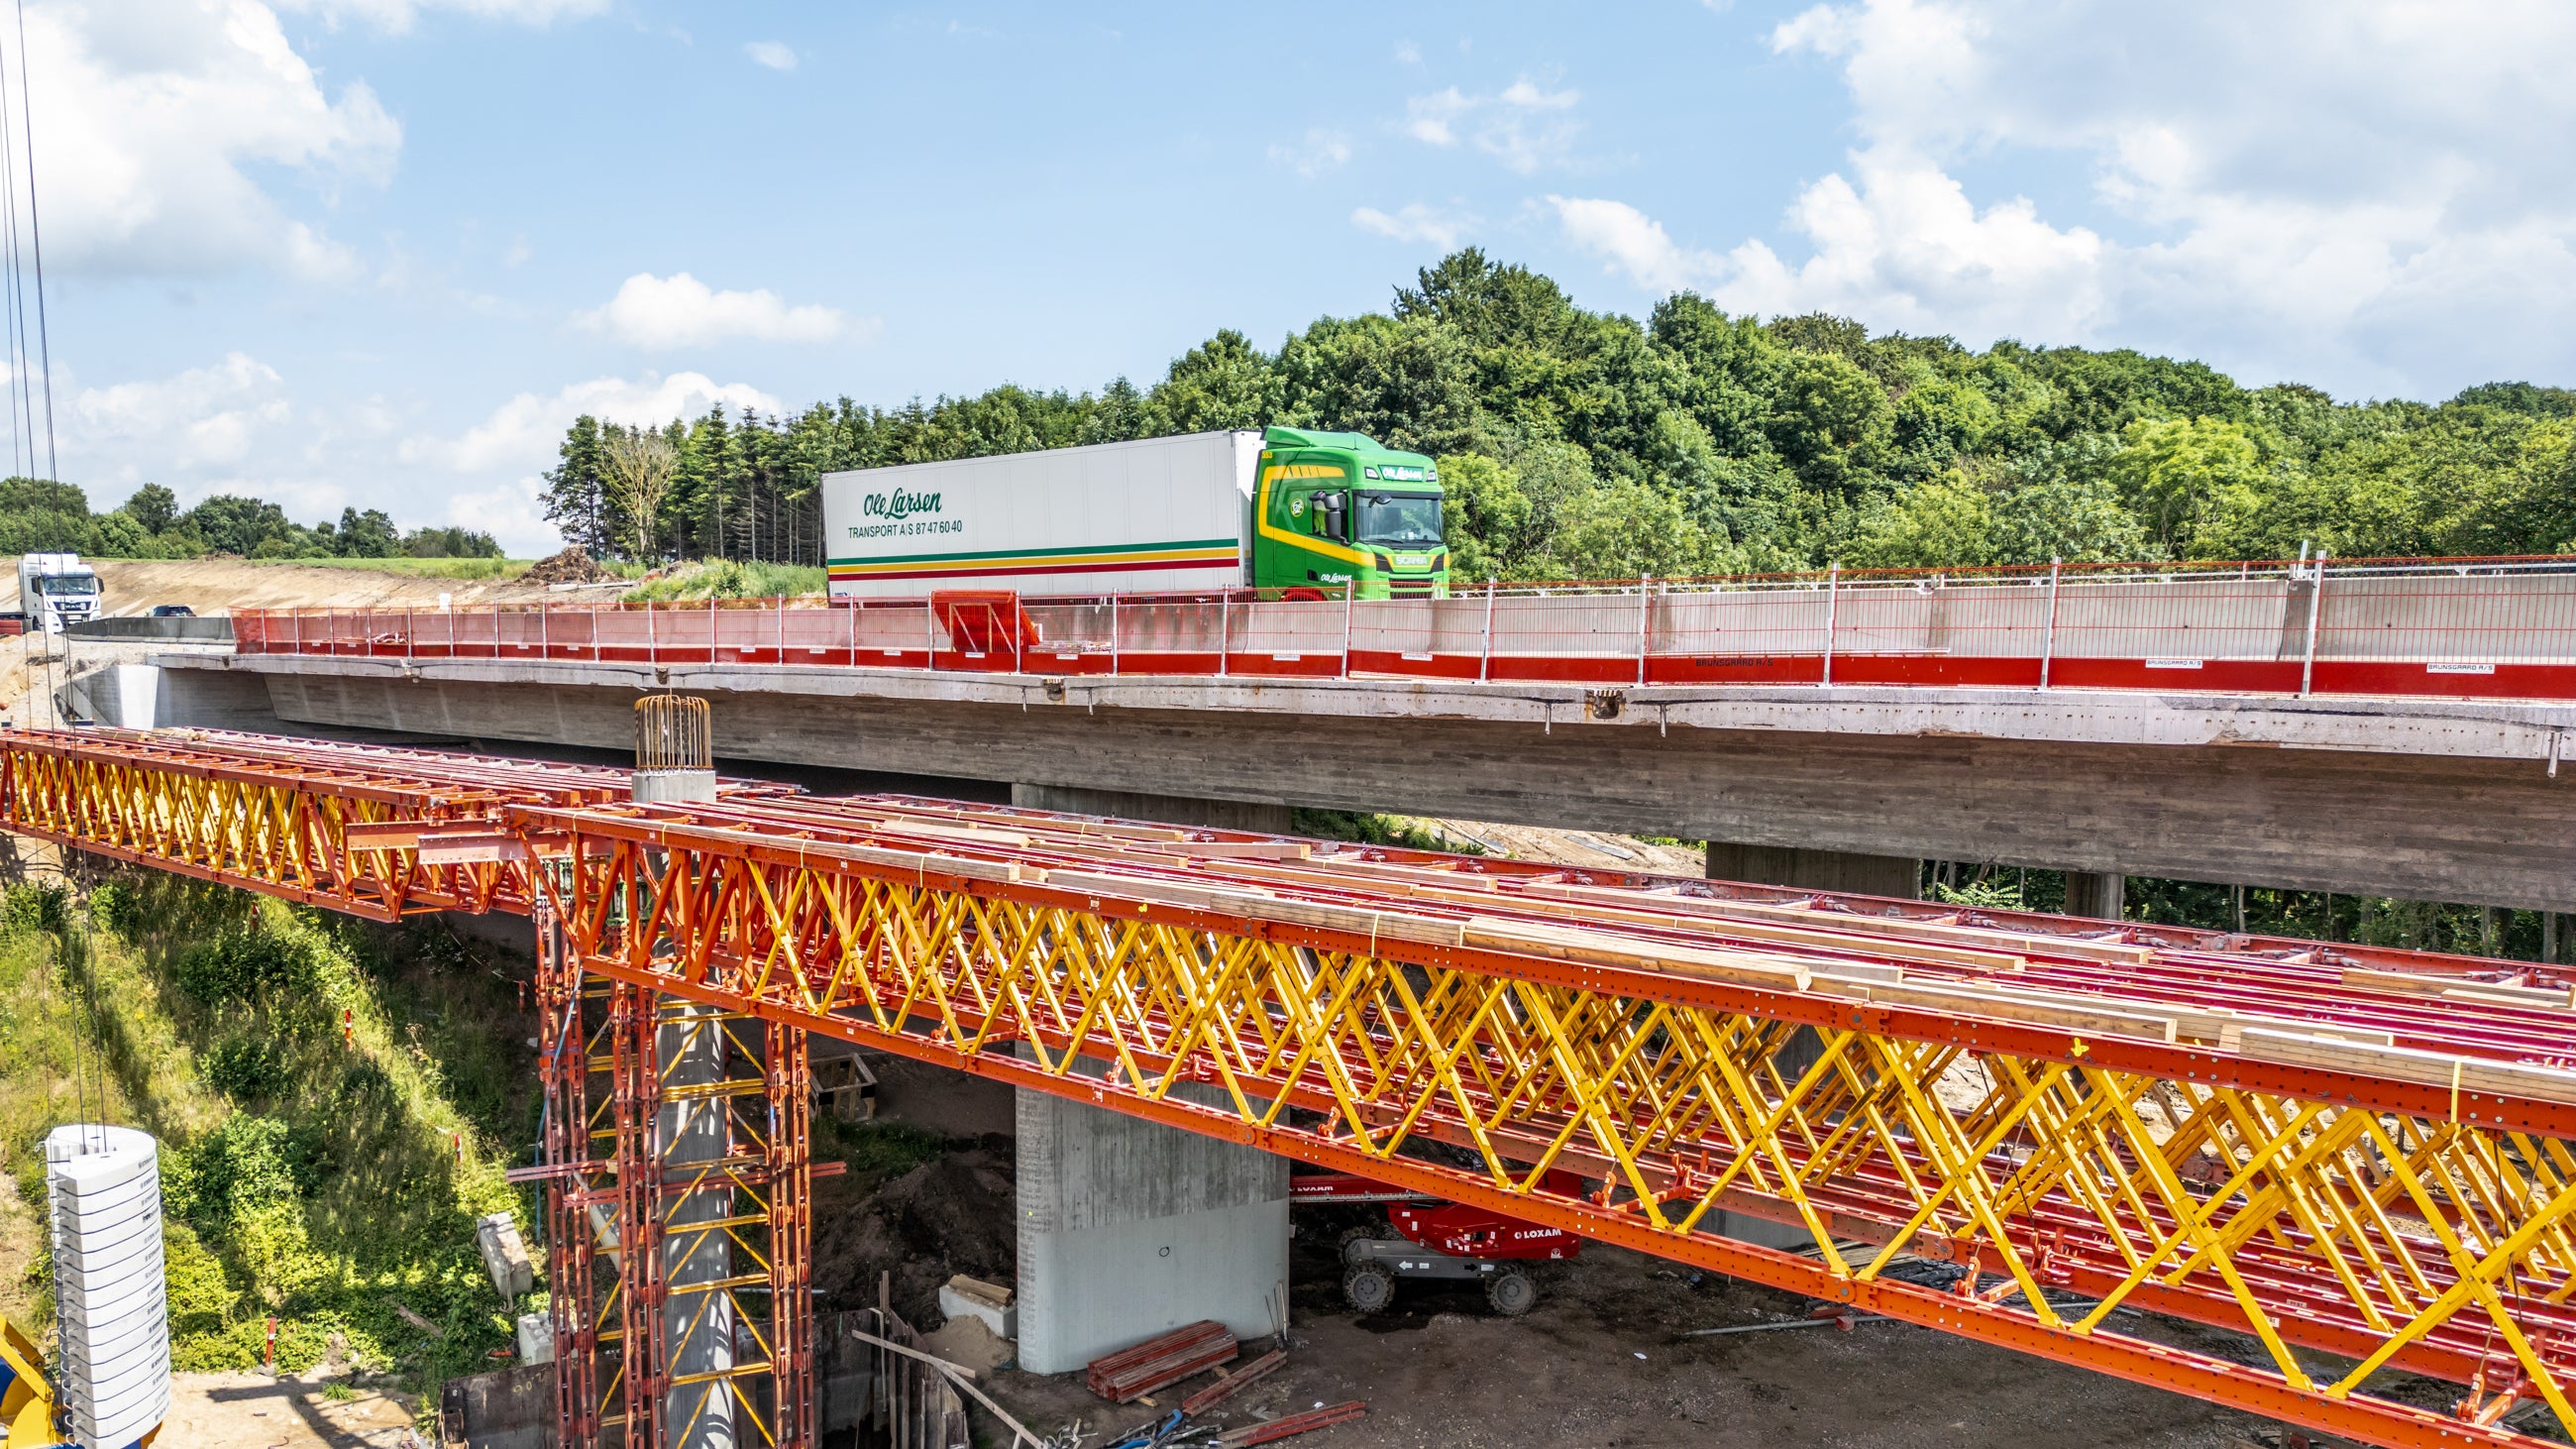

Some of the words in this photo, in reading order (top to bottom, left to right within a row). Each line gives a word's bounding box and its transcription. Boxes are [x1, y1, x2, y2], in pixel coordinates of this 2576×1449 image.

[864, 493, 887, 516] Ole
[884, 487, 942, 519] Larsen
[848, 523, 898, 538] TRANSPORT
[900, 523, 913, 536] A/S
[915, 522, 926, 534] 87
[927, 521, 938, 533] 47
[939, 520, 950, 533] 60
[951, 519, 962, 532] 40
[1395, 556, 1428, 565] SCANIA
[1524, 1229, 1561, 1239] LOXAM
